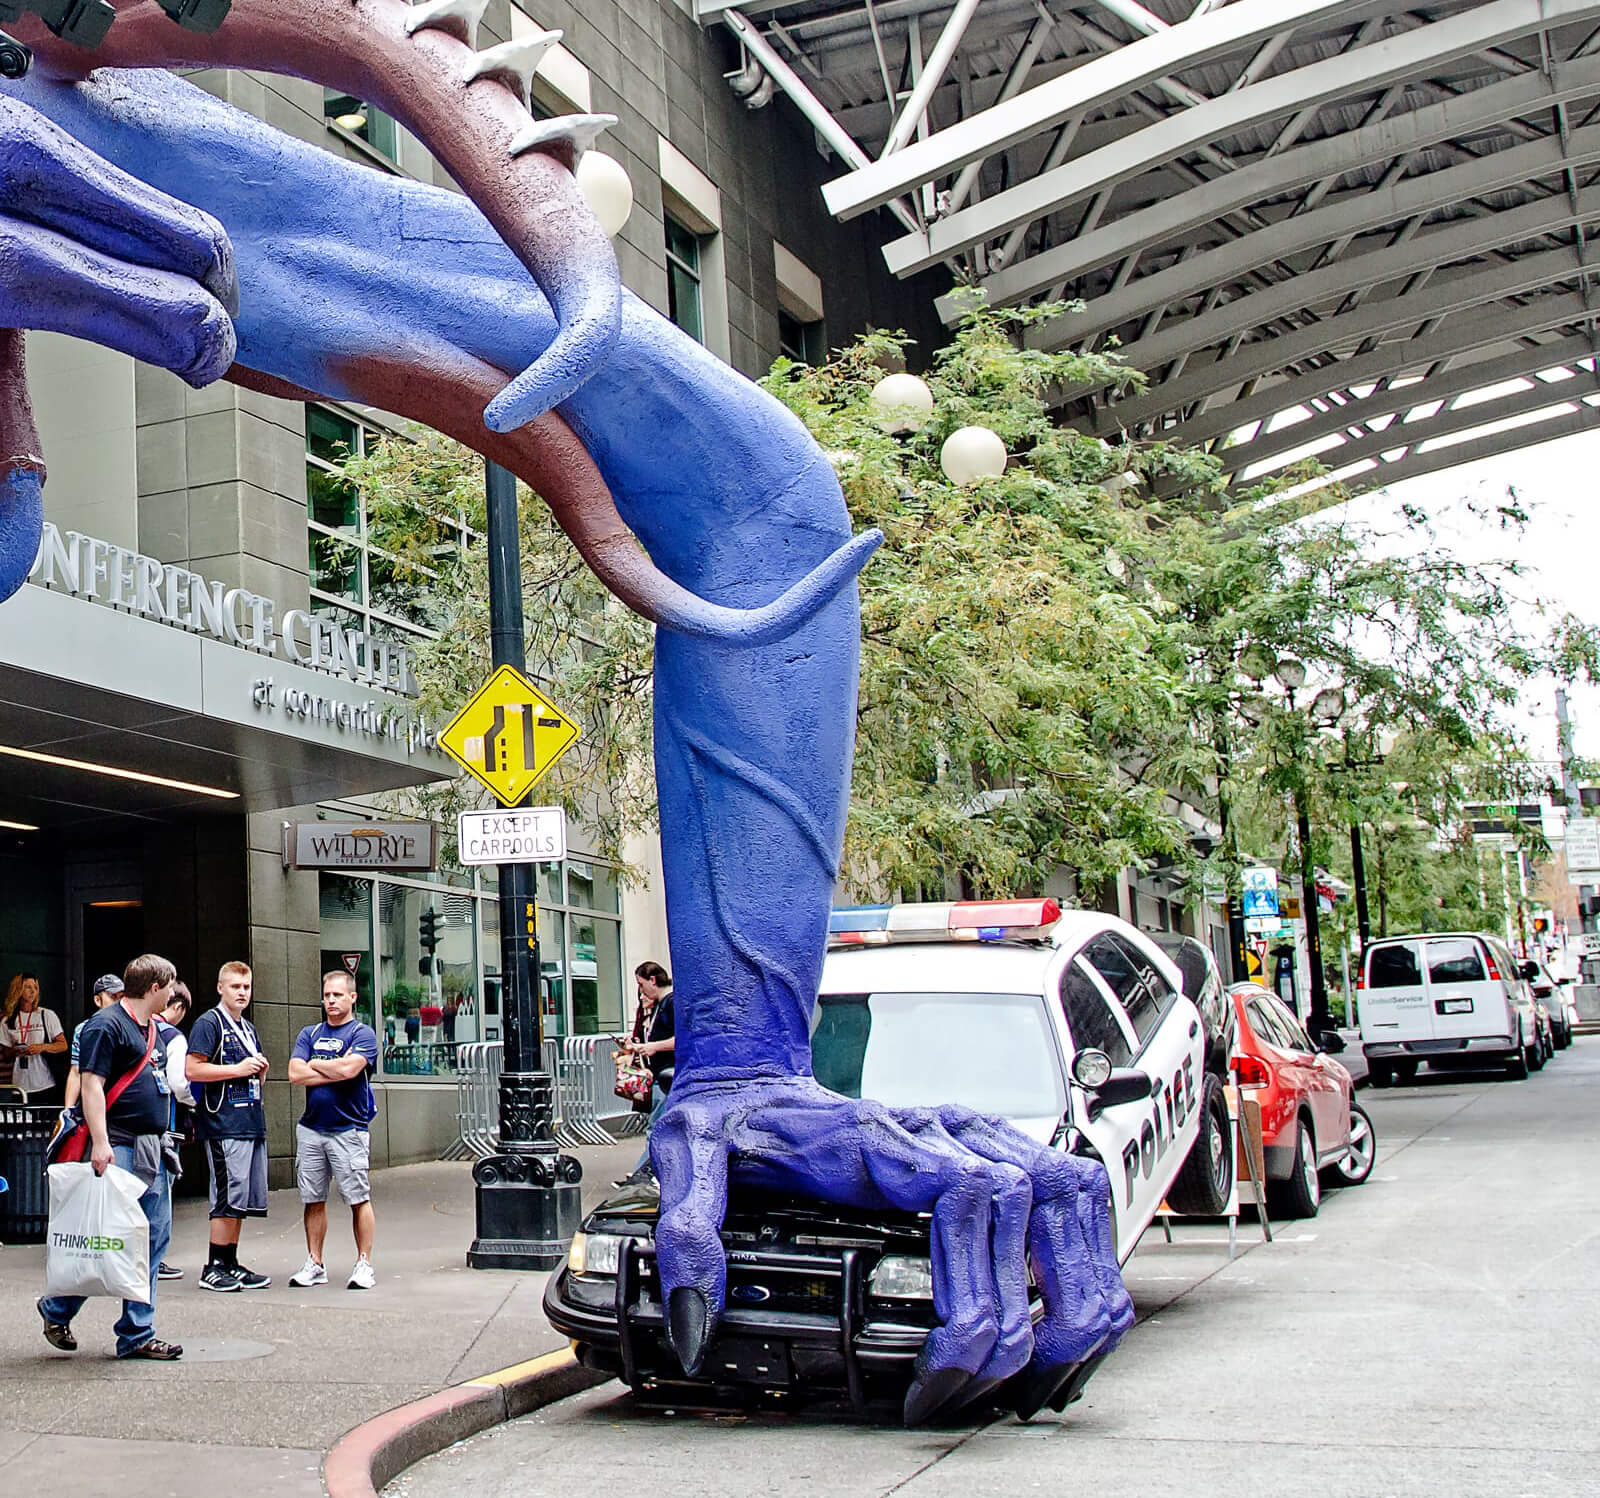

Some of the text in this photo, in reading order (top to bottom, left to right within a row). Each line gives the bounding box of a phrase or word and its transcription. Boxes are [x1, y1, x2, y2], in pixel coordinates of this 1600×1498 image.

[253, 676, 276, 709] at
[482, 816, 540, 835] EXCEPT
[311, 834, 416, 862] WILD RYE
[470, 836, 555, 856] CARPOOLS
[1122, 1052, 1196, 1210] POLICE
